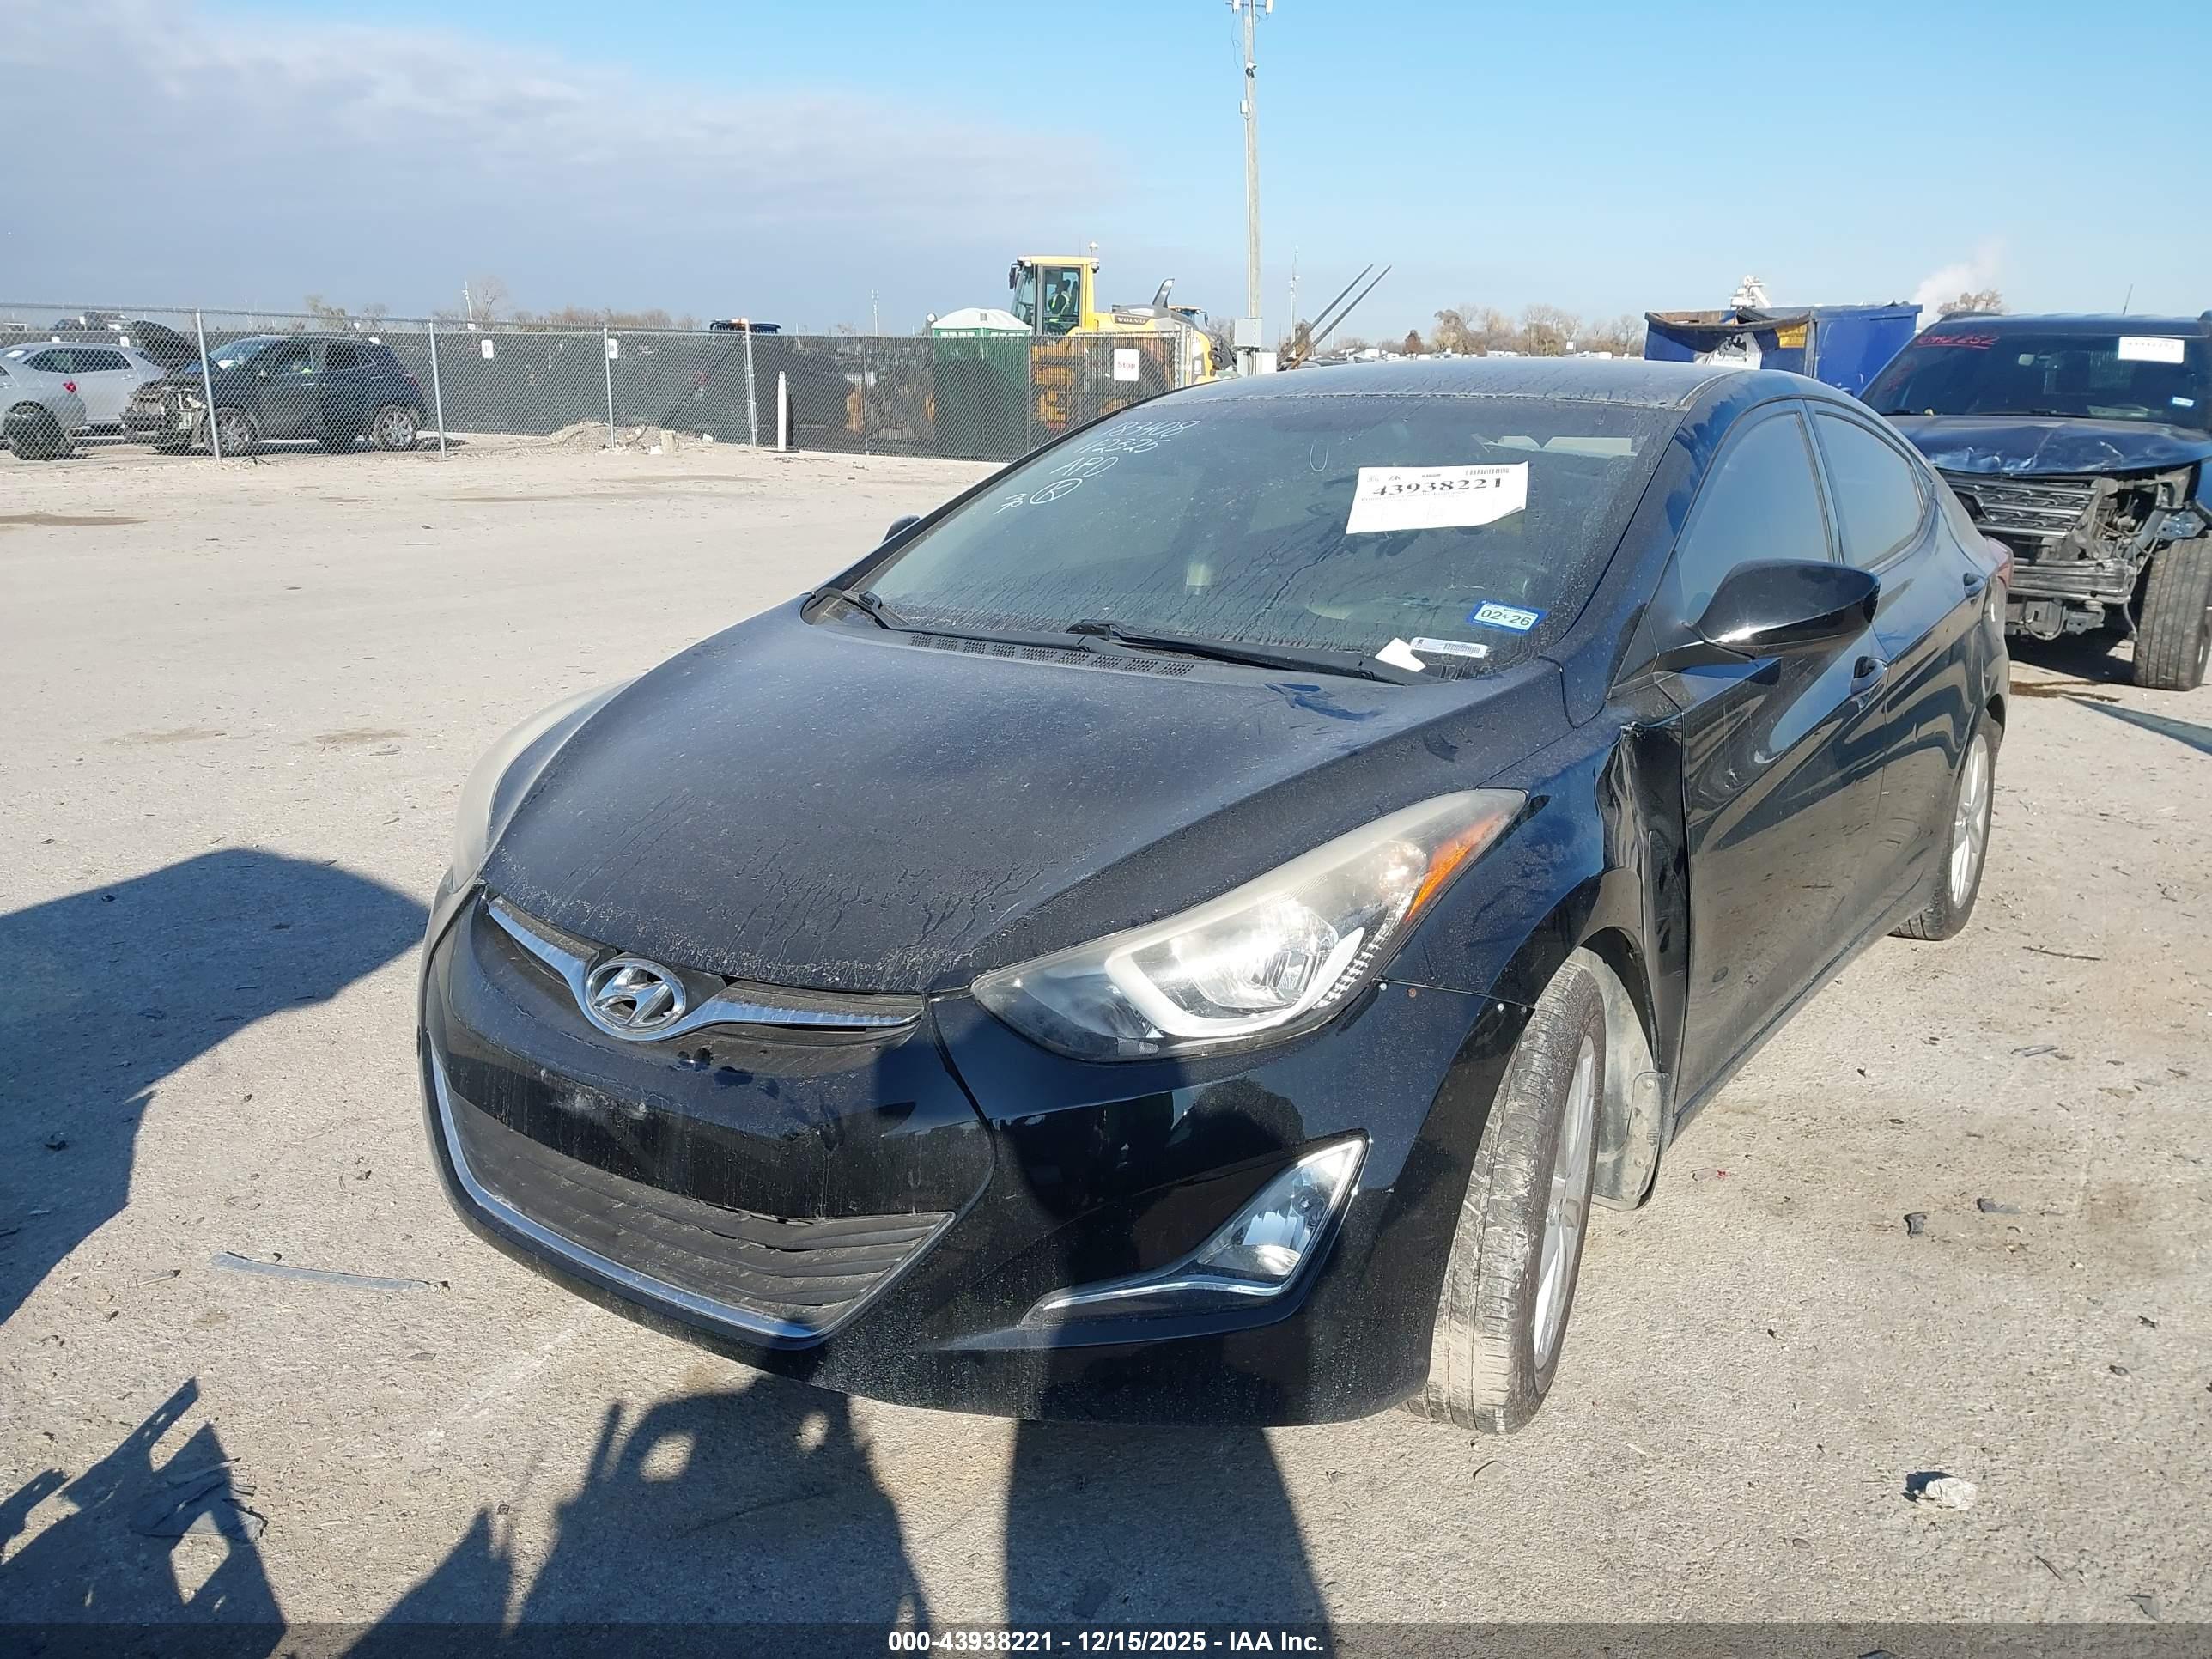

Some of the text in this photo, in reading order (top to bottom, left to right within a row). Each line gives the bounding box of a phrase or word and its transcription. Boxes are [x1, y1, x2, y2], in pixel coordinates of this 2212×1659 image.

[1117, 361, 1136, 370] Stop
[1372, 477, 1501, 495] 43938221
[1481, 609, 1532, 626] 02 26
